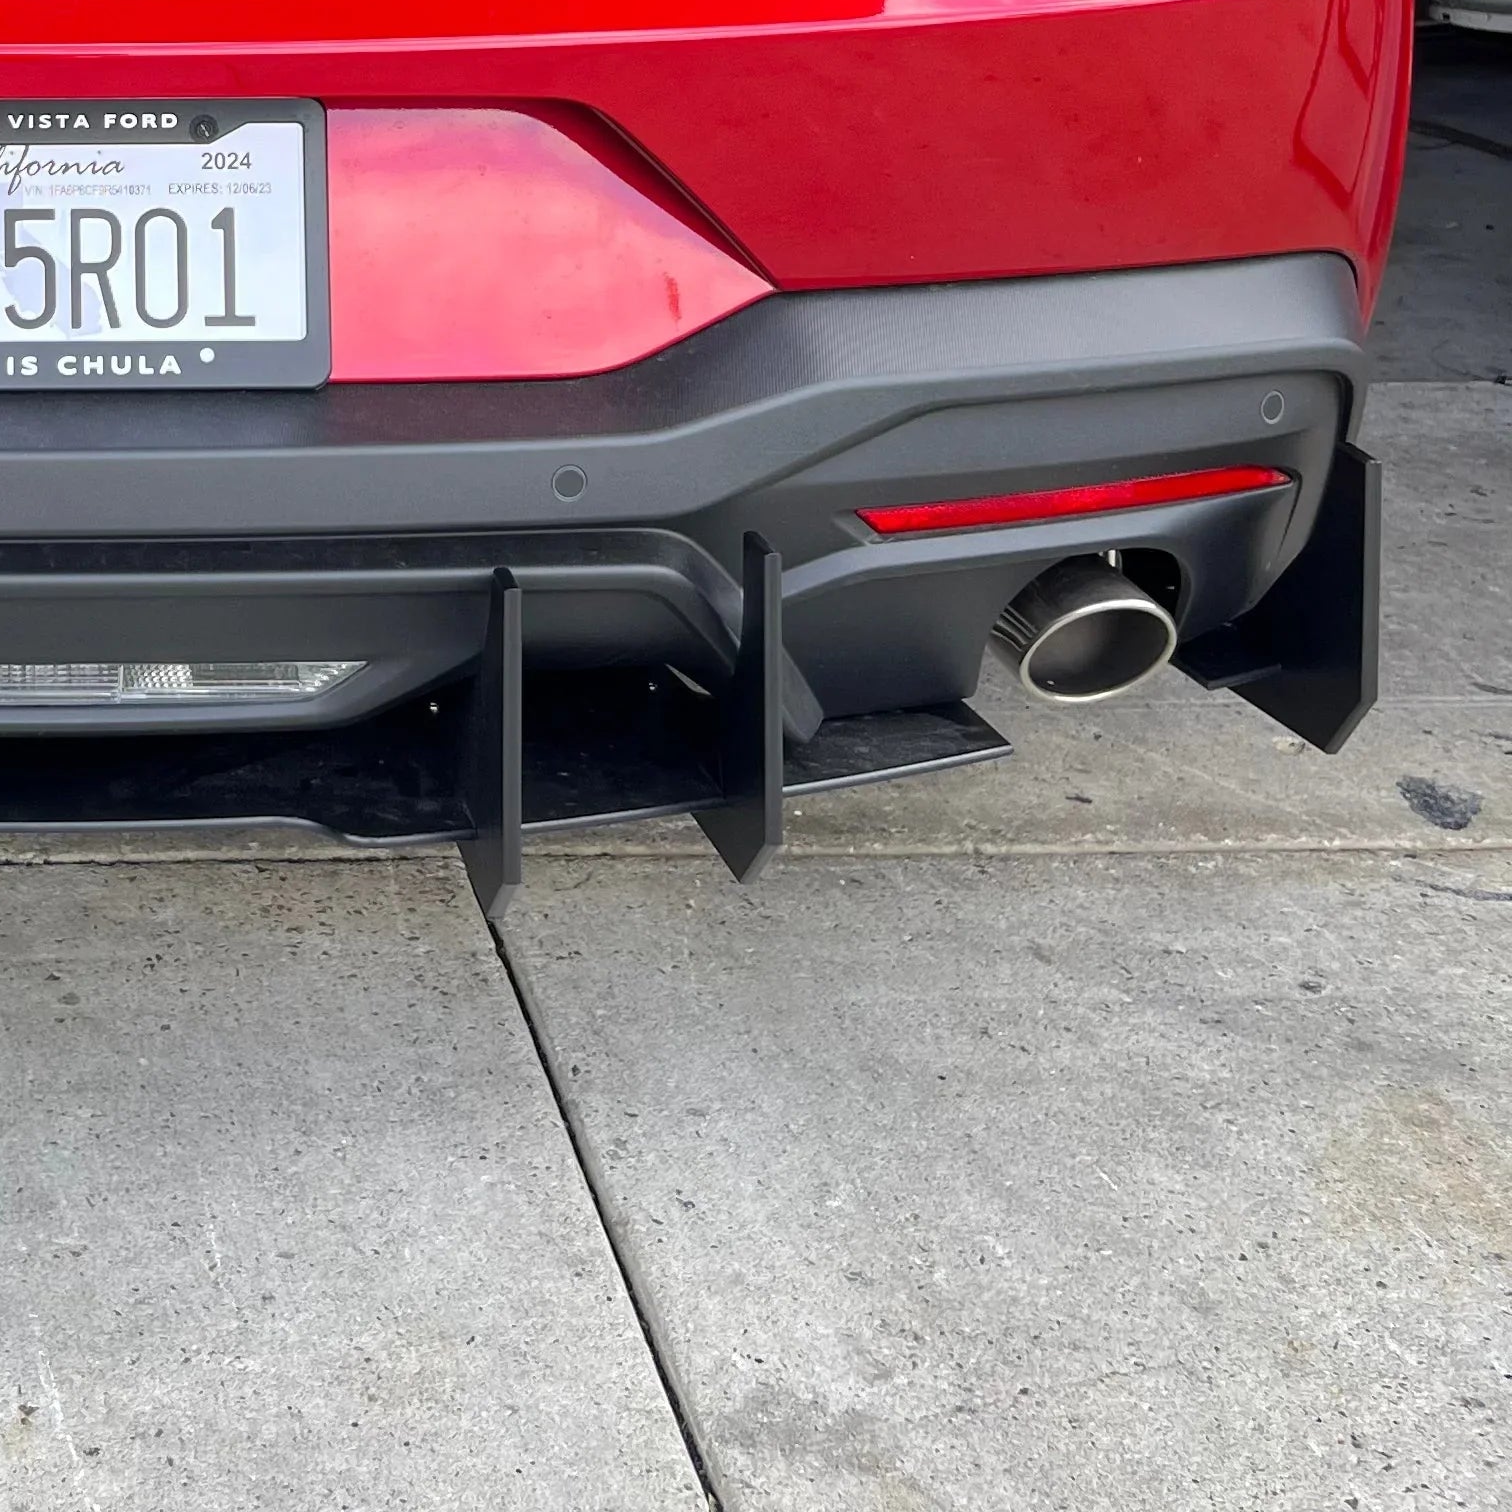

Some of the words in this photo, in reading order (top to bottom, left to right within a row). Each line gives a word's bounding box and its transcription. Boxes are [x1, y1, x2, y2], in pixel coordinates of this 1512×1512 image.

[7, 113, 90, 129] VISTA
[104, 112, 179, 129] FORD
[201, 152, 252, 170] 2024
[168, 183, 223, 194] EXPIRES:
[227, 182, 272, 194] 12/06/23
[6, 354, 39, 376] IS
[57, 354, 182, 376] CHULA
